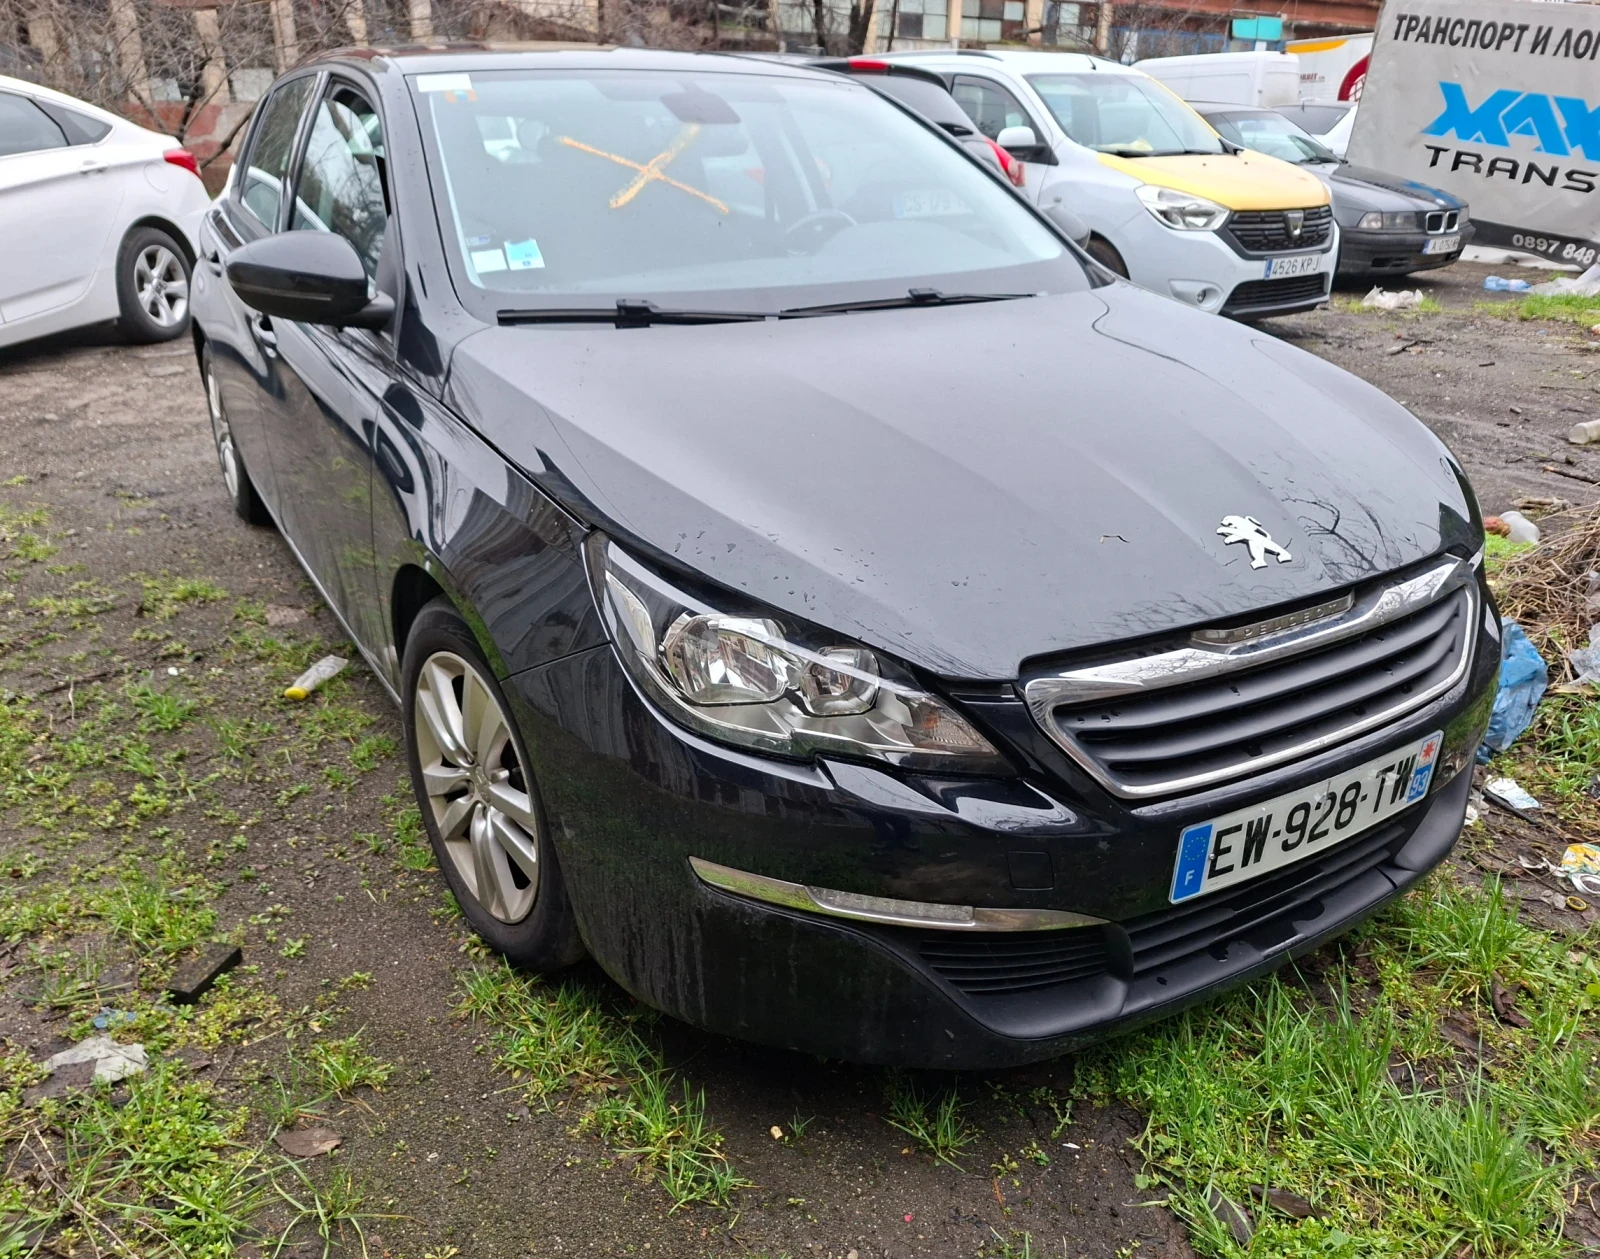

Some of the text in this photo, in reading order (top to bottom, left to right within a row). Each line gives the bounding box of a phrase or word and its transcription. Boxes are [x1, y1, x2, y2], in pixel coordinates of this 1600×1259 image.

[1393, 13, 1530, 53] ТРАНСПОРТ
[1529, 25, 1553, 55] И
[1424, 144, 1600, 194] TRANS
[1512, 233, 1561, 254] 0897
[1562, 243, 1596, 265] 848
[1272, 258, 1298, 275] 4526
[1410, 769, 1431, 797] 93
[1207, 753, 1418, 880] EW-928-TW
[1183, 869, 1195, 886] F
